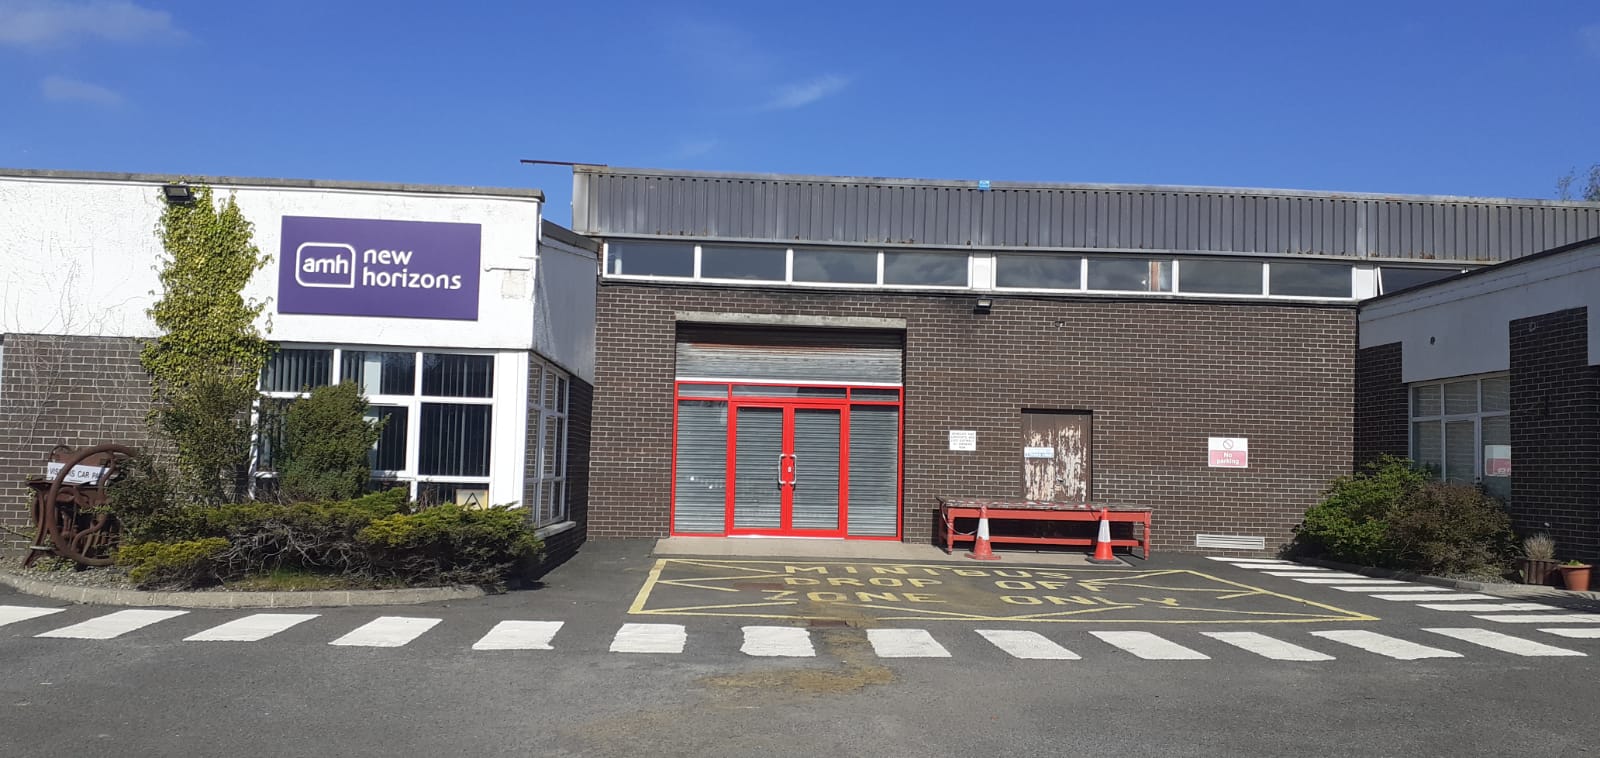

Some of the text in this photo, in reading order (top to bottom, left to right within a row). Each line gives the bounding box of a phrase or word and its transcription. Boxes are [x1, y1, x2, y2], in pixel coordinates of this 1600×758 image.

[302, 254, 349, 274] amh
[363, 249, 413, 265] new
[362, 266, 462, 290] horizons
[77, 470, 90, 478] CAR
[784, 565, 1073, 579] MINIBUS
[784, 577, 1108, 592] DROP OFF
[761, 589, 1180, 606] ZONE ONLY
